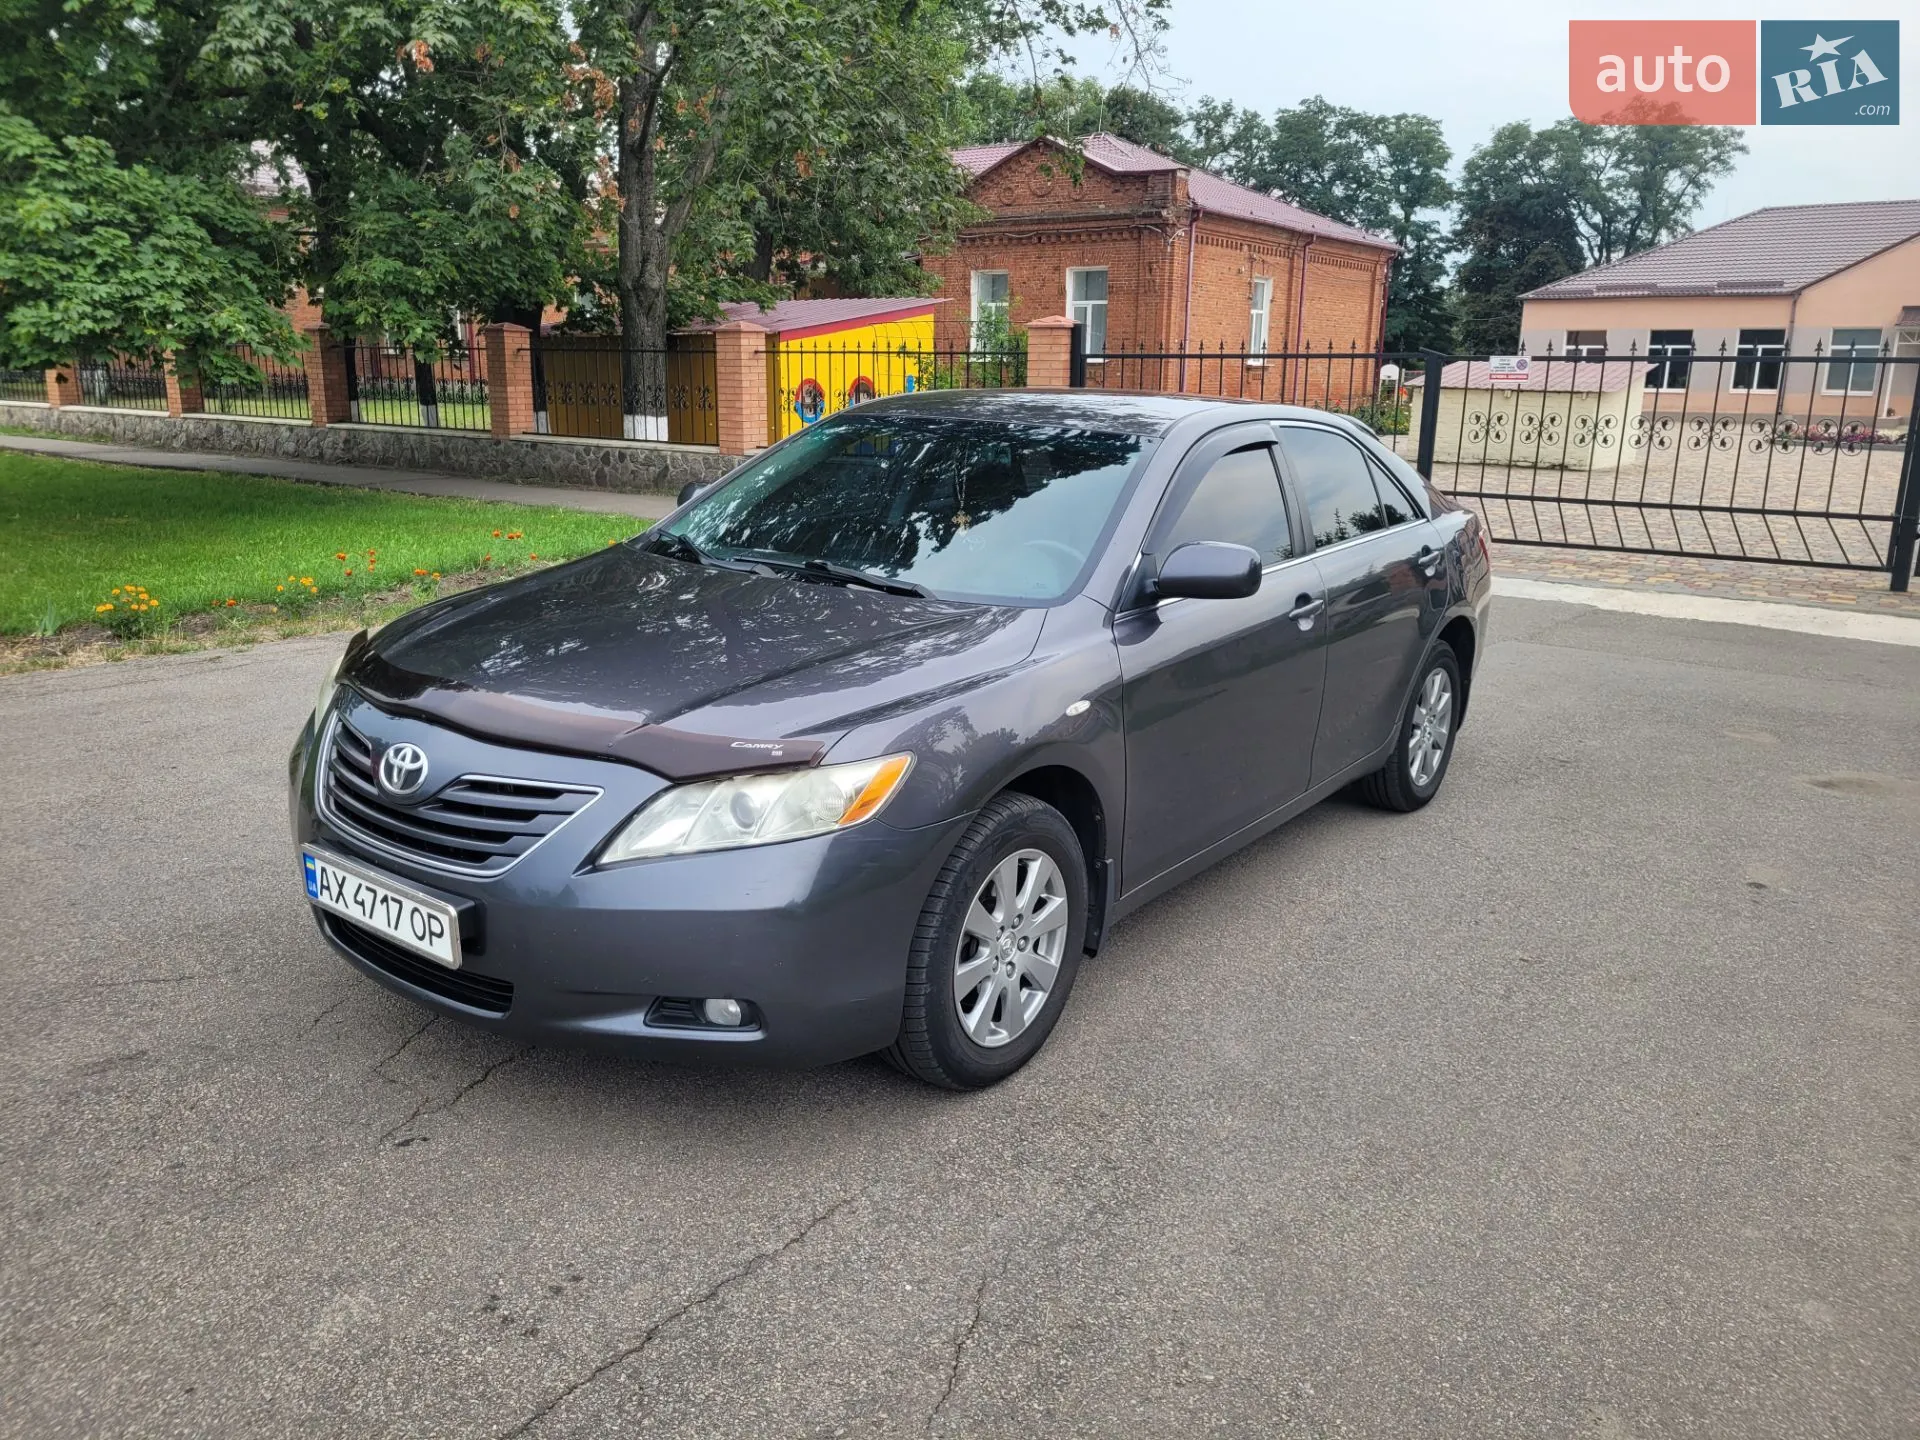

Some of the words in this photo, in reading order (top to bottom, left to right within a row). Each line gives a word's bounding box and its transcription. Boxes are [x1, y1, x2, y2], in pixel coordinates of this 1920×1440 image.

[308, 879, 317, 893] UA
[319, 866, 349, 910] AX
[353, 883, 403, 931] 4717
[410, 906, 445, 947] OP
